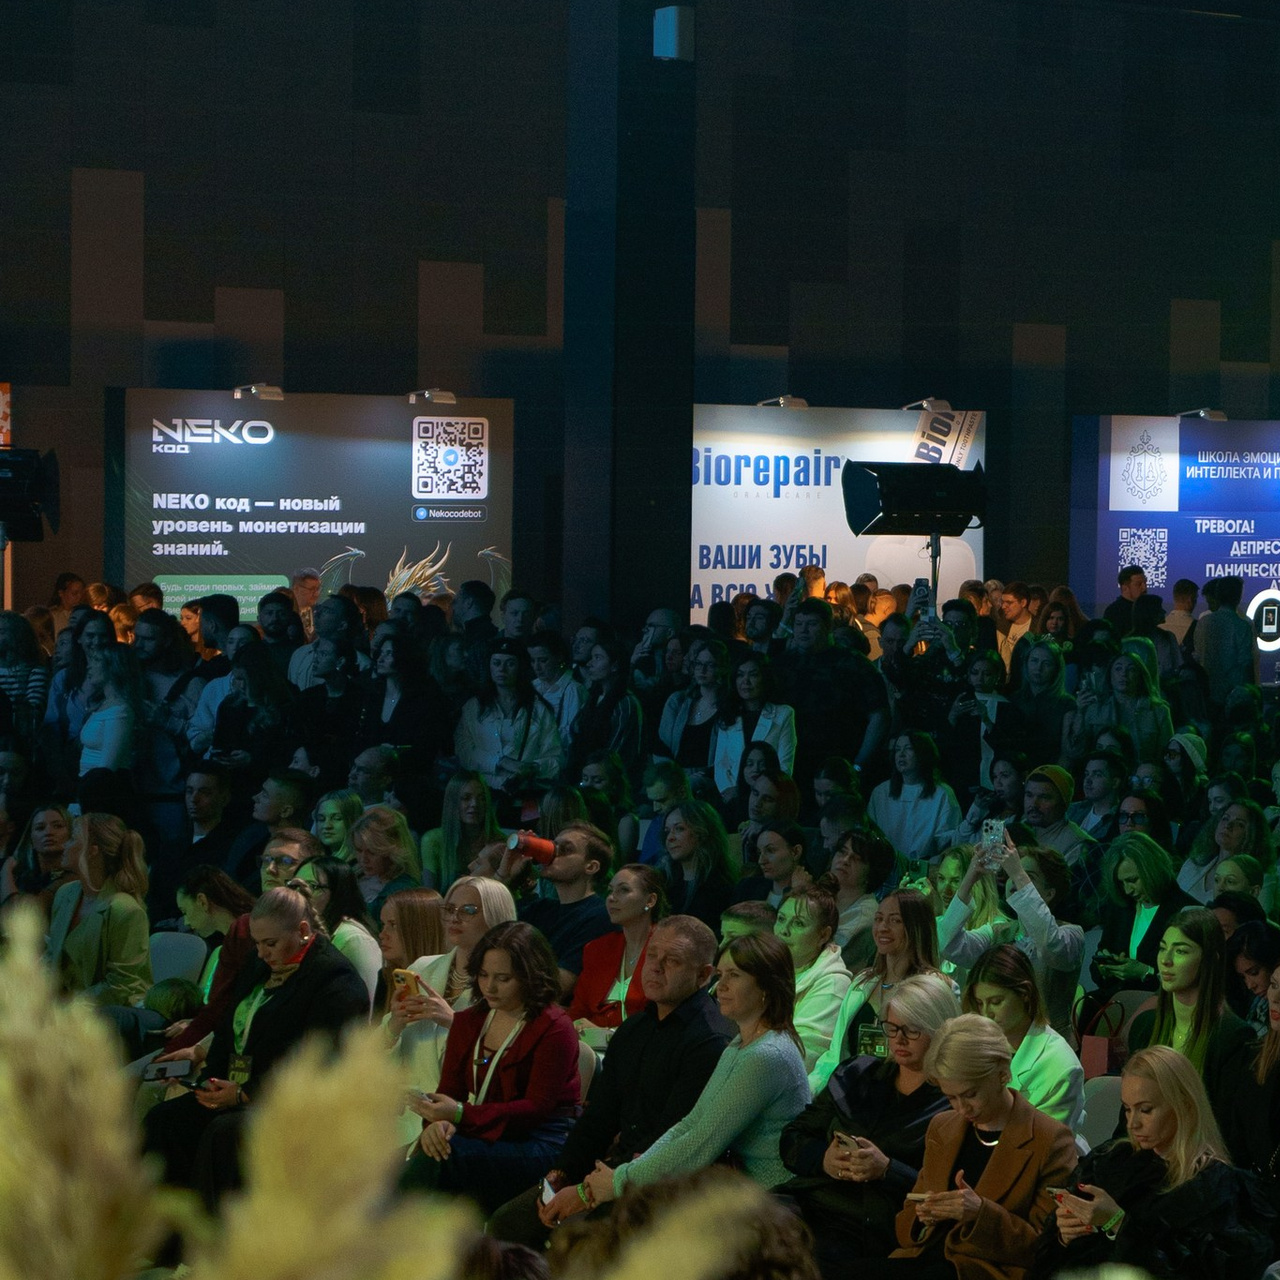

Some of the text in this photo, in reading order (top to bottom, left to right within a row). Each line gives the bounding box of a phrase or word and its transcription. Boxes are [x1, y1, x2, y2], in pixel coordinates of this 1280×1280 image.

[152, 418, 274, 444] NEKO
[960, 412, 977, 451] TOOTHPASTE
[1198, 451, 1240, 463] ШКОЛА
[1186, 466, 1261, 479] ИНТЕЛЛЕКТА
[1263, 467, 1271, 479] И
[733, 491, 821, 499] ORAL CARE
[152, 493, 209, 509] NEKO
[215, 497, 250, 512] код
[279, 496, 340, 511] новый
[428, 509, 481, 518] Nekocodebot
[152, 520, 365, 536] уровень монетизации
[1195, 520, 1255, 533] ТРЕВОГА!
[152, 540, 228, 556] знаний.
[698, 544, 827, 569] ВАШИ ЗУБЫ
[160, 582, 181, 593] Будь
[184, 583, 210, 592] среди
